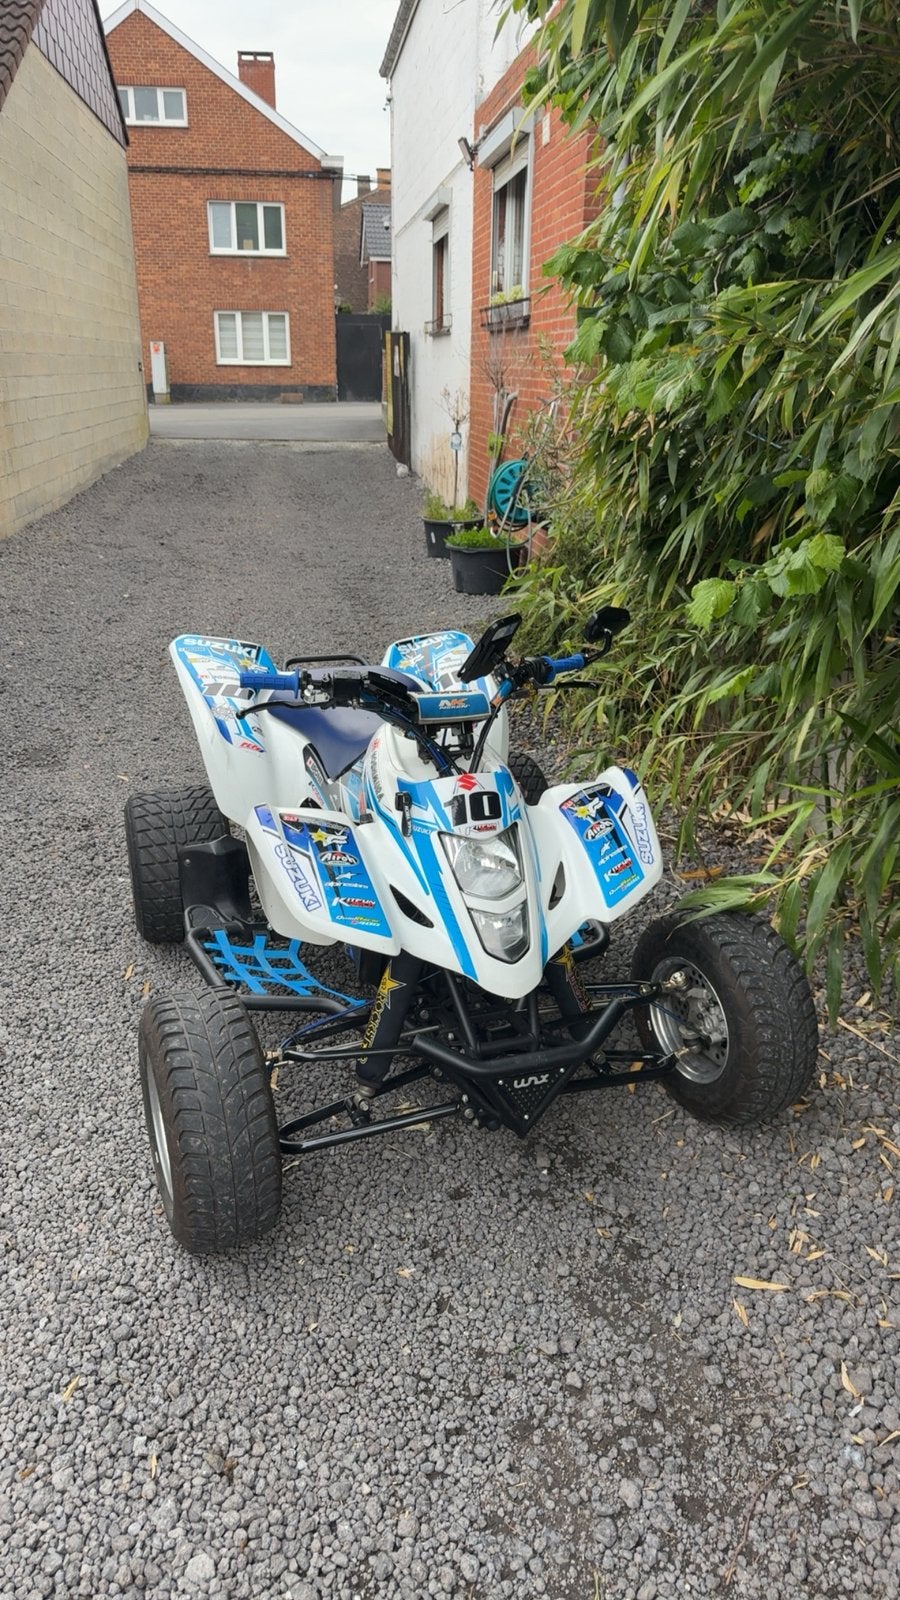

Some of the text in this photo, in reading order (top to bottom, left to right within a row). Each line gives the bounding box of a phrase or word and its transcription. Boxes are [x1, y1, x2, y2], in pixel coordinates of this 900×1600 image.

[183, 638, 258, 662] SUZUKI
[397, 633, 456, 655] SUZUKI
[443, 791, 503, 827] 10
[320, 851, 358, 865] Airoh
[274, 843, 322, 912] SUZUKI
